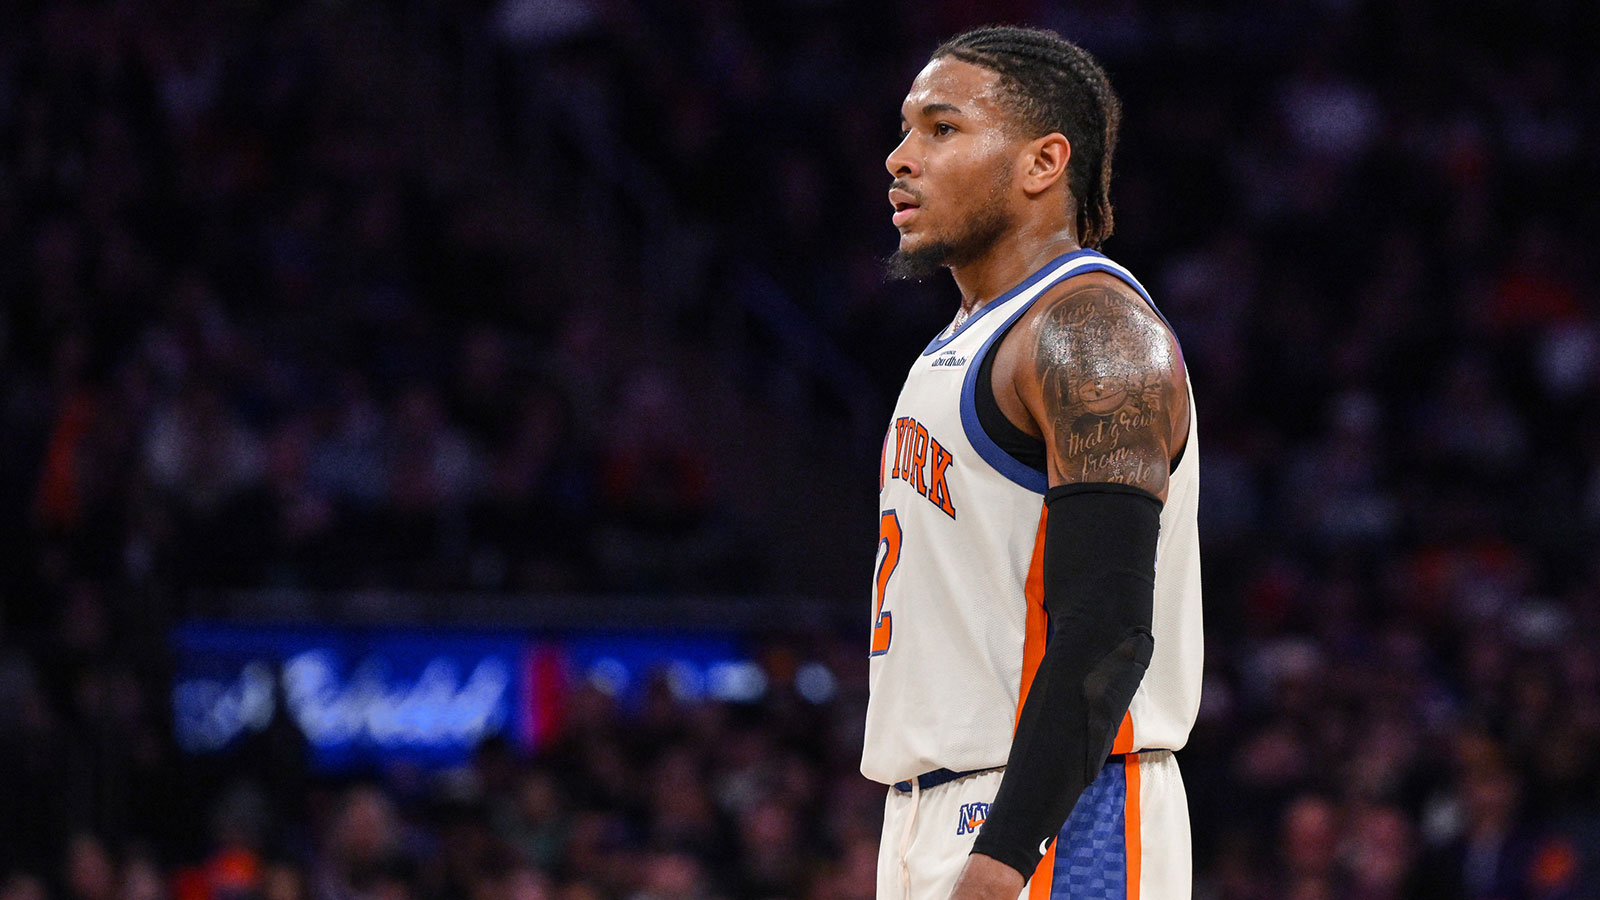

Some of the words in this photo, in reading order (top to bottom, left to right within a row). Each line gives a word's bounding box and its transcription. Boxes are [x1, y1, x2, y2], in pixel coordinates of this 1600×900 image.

[892, 416, 956, 520] YORK
[1067, 419, 1108, 458] that
[1108, 409, 1155, 450] grew
[1081, 446, 1130, 482] from
[869, 508, 903, 659] 2
